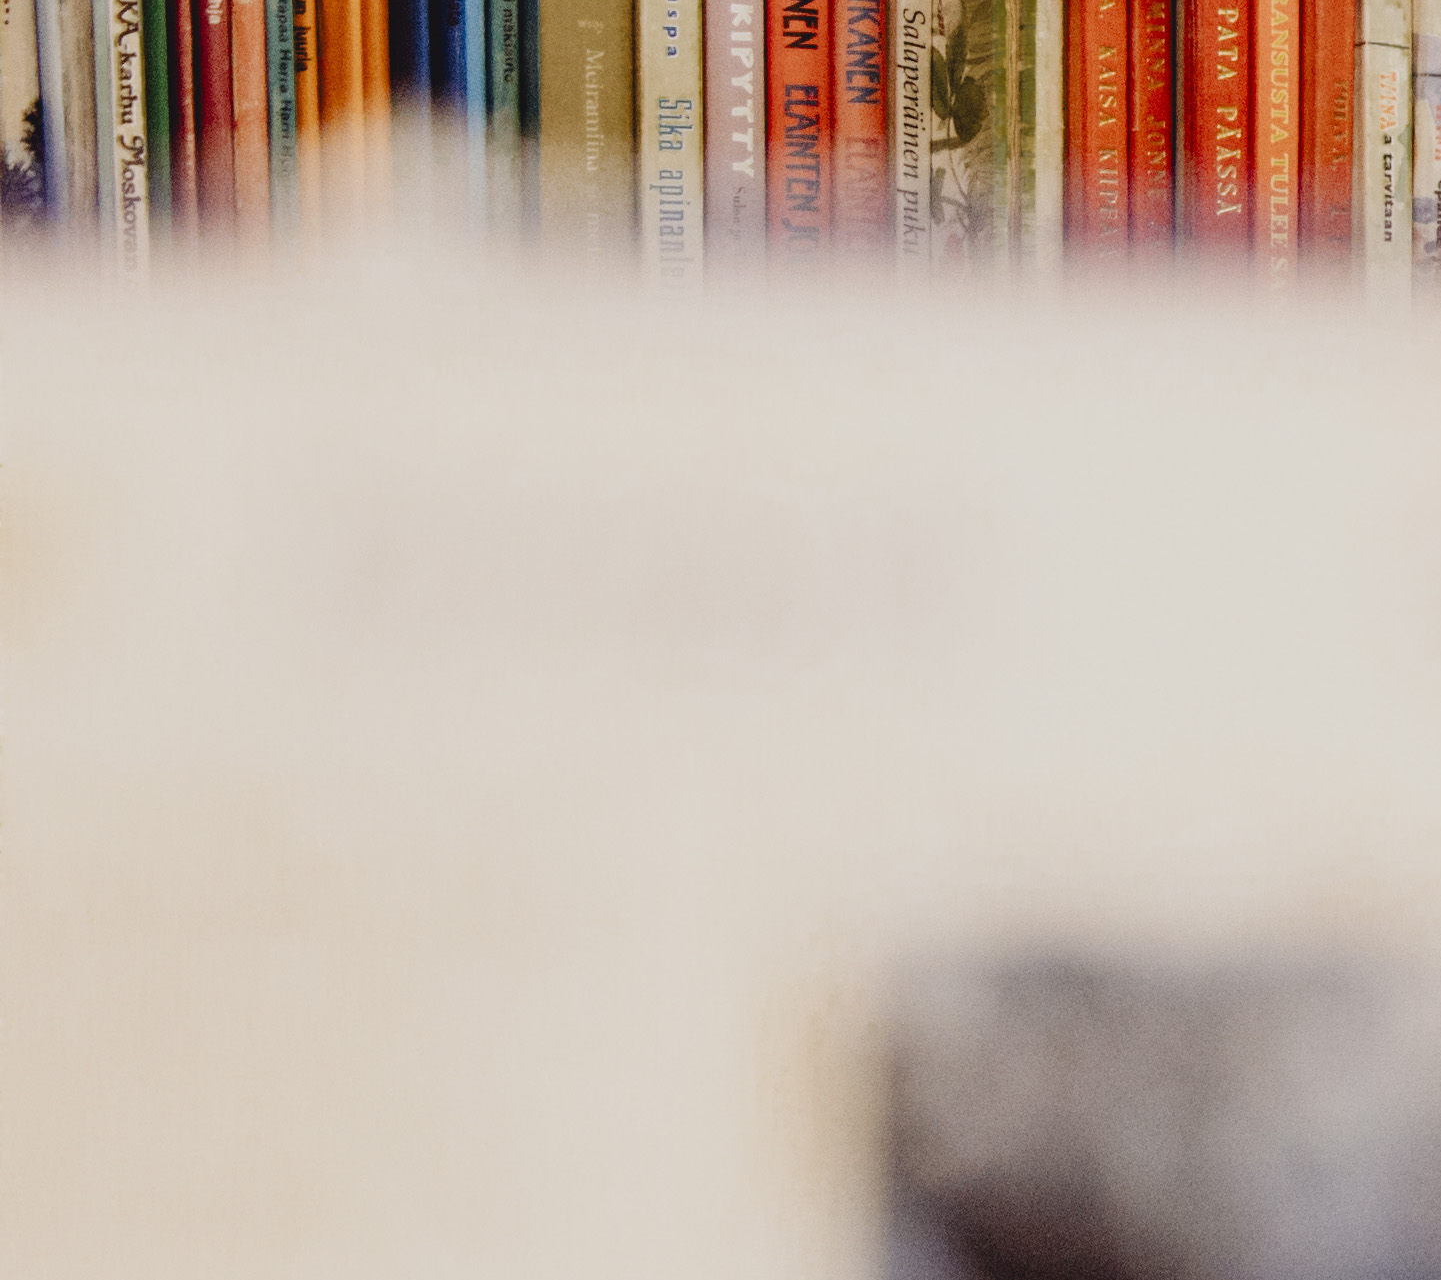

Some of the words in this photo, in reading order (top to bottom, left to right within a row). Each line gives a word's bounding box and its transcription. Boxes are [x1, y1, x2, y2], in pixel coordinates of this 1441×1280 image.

[1097, 45, 1119, 128] KAISA
[1216, 6, 1240, 81] PATA
[657, 97, 694, 152] Sika
[896, 8, 928, 180] Salaperäinen
[784, 84, 822, 212] ELÄINTEN
[1216, 106, 1243, 216] PÄÄSSÄ
[896, 188, 926, 255] puku
[1269, 152, 1290, 248] TULEE
[1381, 153, 1396, 243] tarvitaan
